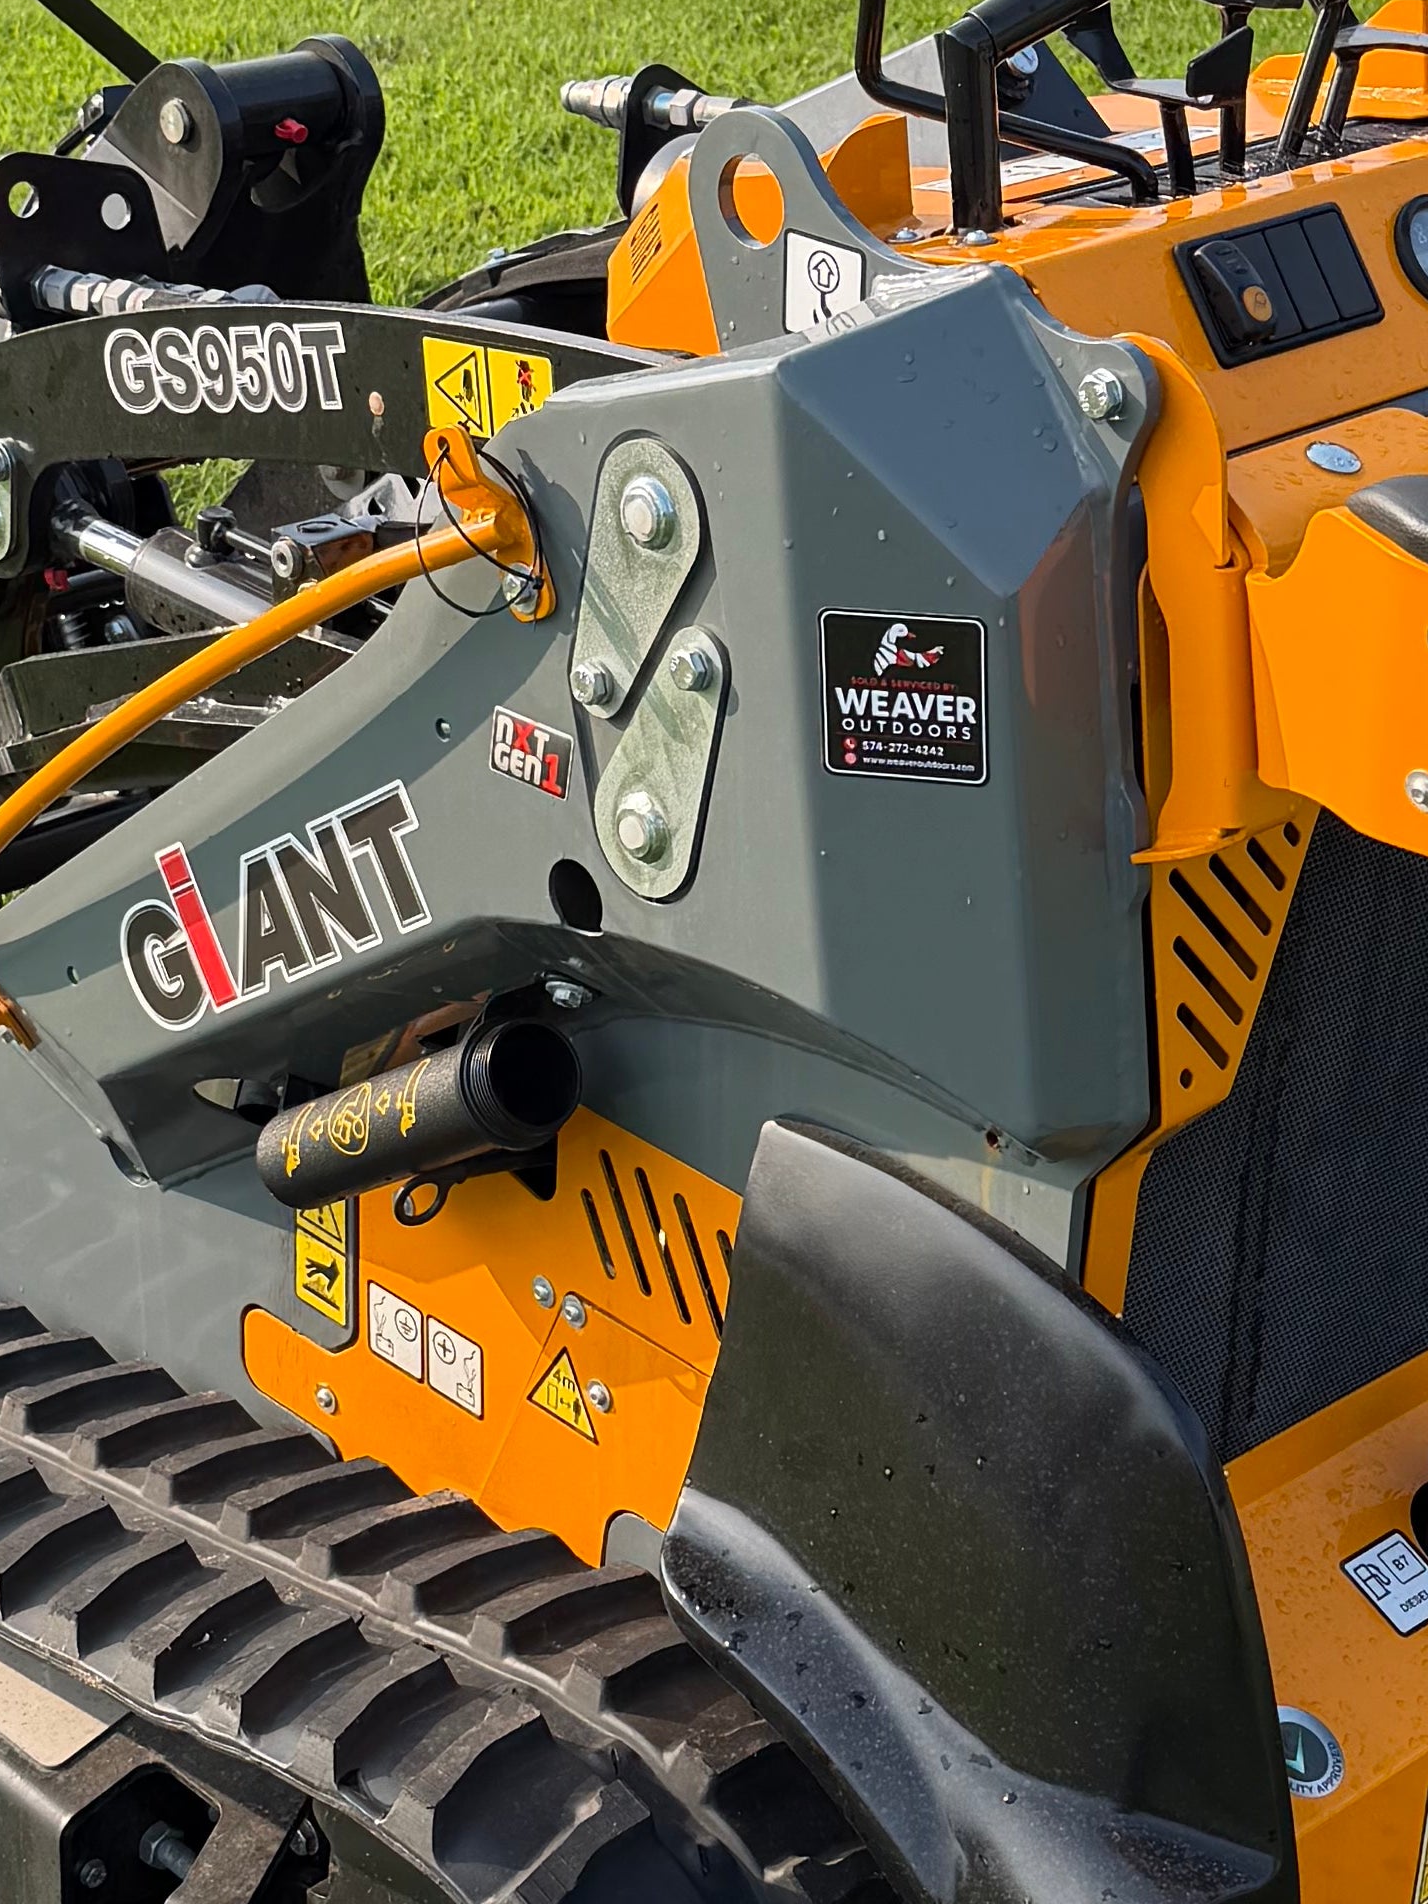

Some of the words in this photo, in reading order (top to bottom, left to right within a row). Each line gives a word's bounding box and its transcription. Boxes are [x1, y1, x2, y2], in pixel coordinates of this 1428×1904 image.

[104, 321, 346, 415] GS950T
[851, 675, 878, 687] SOLD
[891, 678, 941, 692] SERVICED
[834, 686, 977, 725] WEAVER
[841, 717, 972, 740] OUTDOORS
[862, 739, 945, 757] 574-272-4242
[552, 1368, 576, 1393] 4m
[1392, 1554, 1409, 1571] B7
[1289, 1780, 1313, 1794] LITY
[1316, 1742, 1343, 1794] APPROVED
